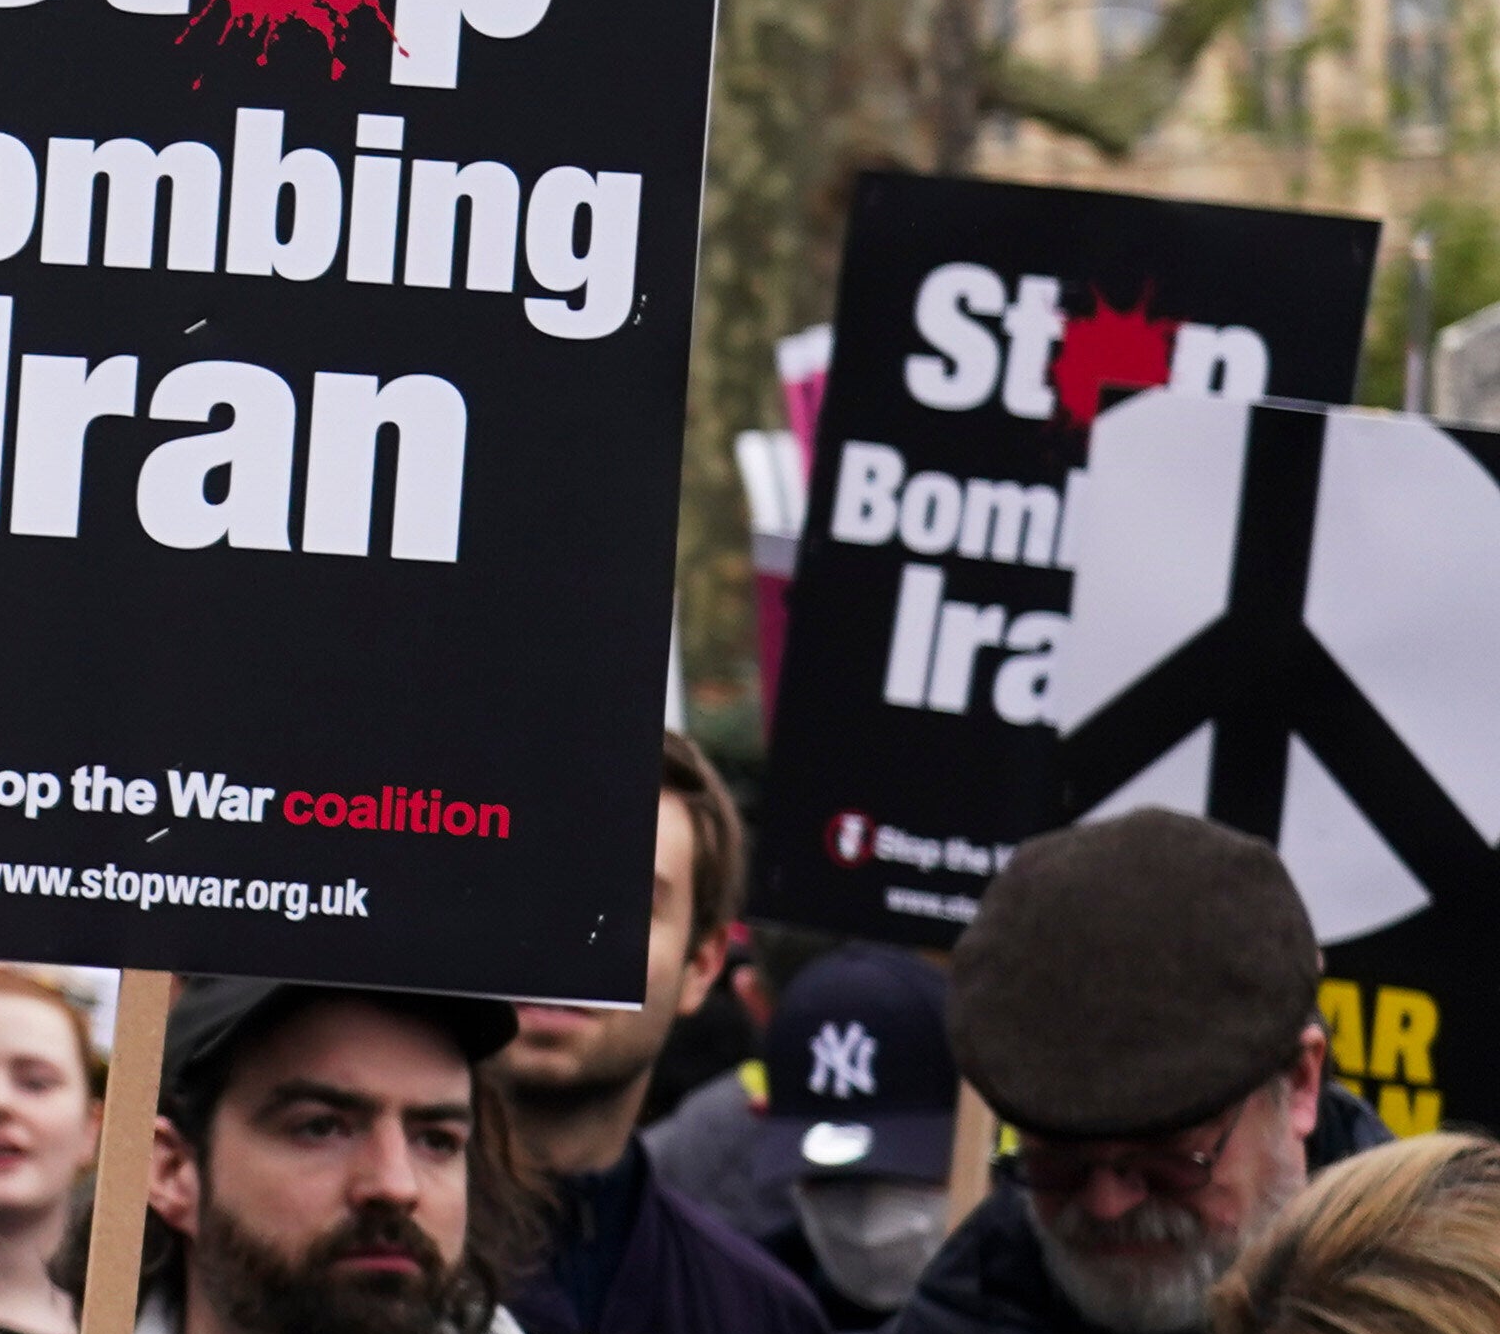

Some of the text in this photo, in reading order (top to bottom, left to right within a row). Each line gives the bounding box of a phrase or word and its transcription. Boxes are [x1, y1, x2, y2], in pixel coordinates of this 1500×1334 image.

[70, 765, 157, 816] the
[167, 769, 276, 823] War
[282, 785, 512, 839] coalition
